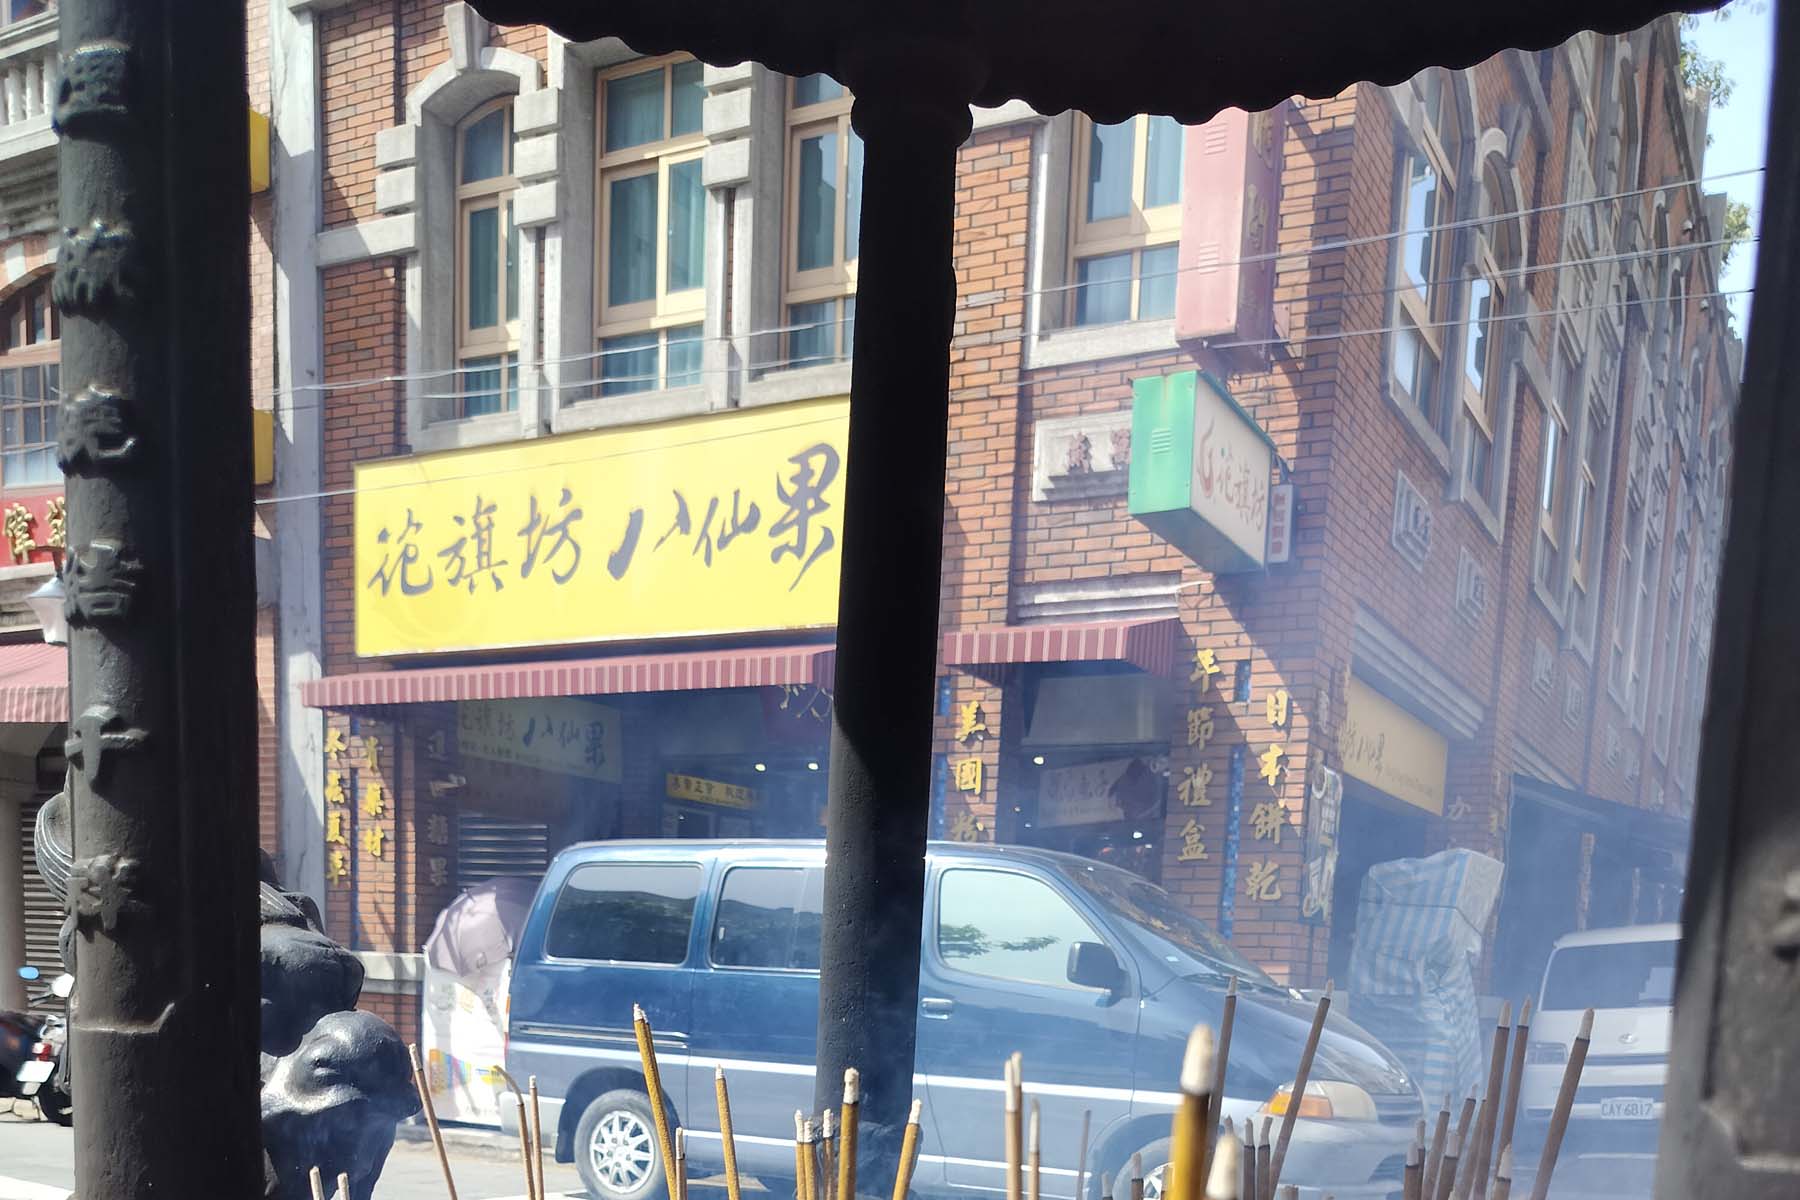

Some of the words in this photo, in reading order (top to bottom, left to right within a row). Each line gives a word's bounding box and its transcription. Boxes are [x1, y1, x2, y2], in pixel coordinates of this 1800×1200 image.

[1176, 648, 1221, 863] 年節禮盒
[1244, 689, 1290, 902] 日本餅乾
